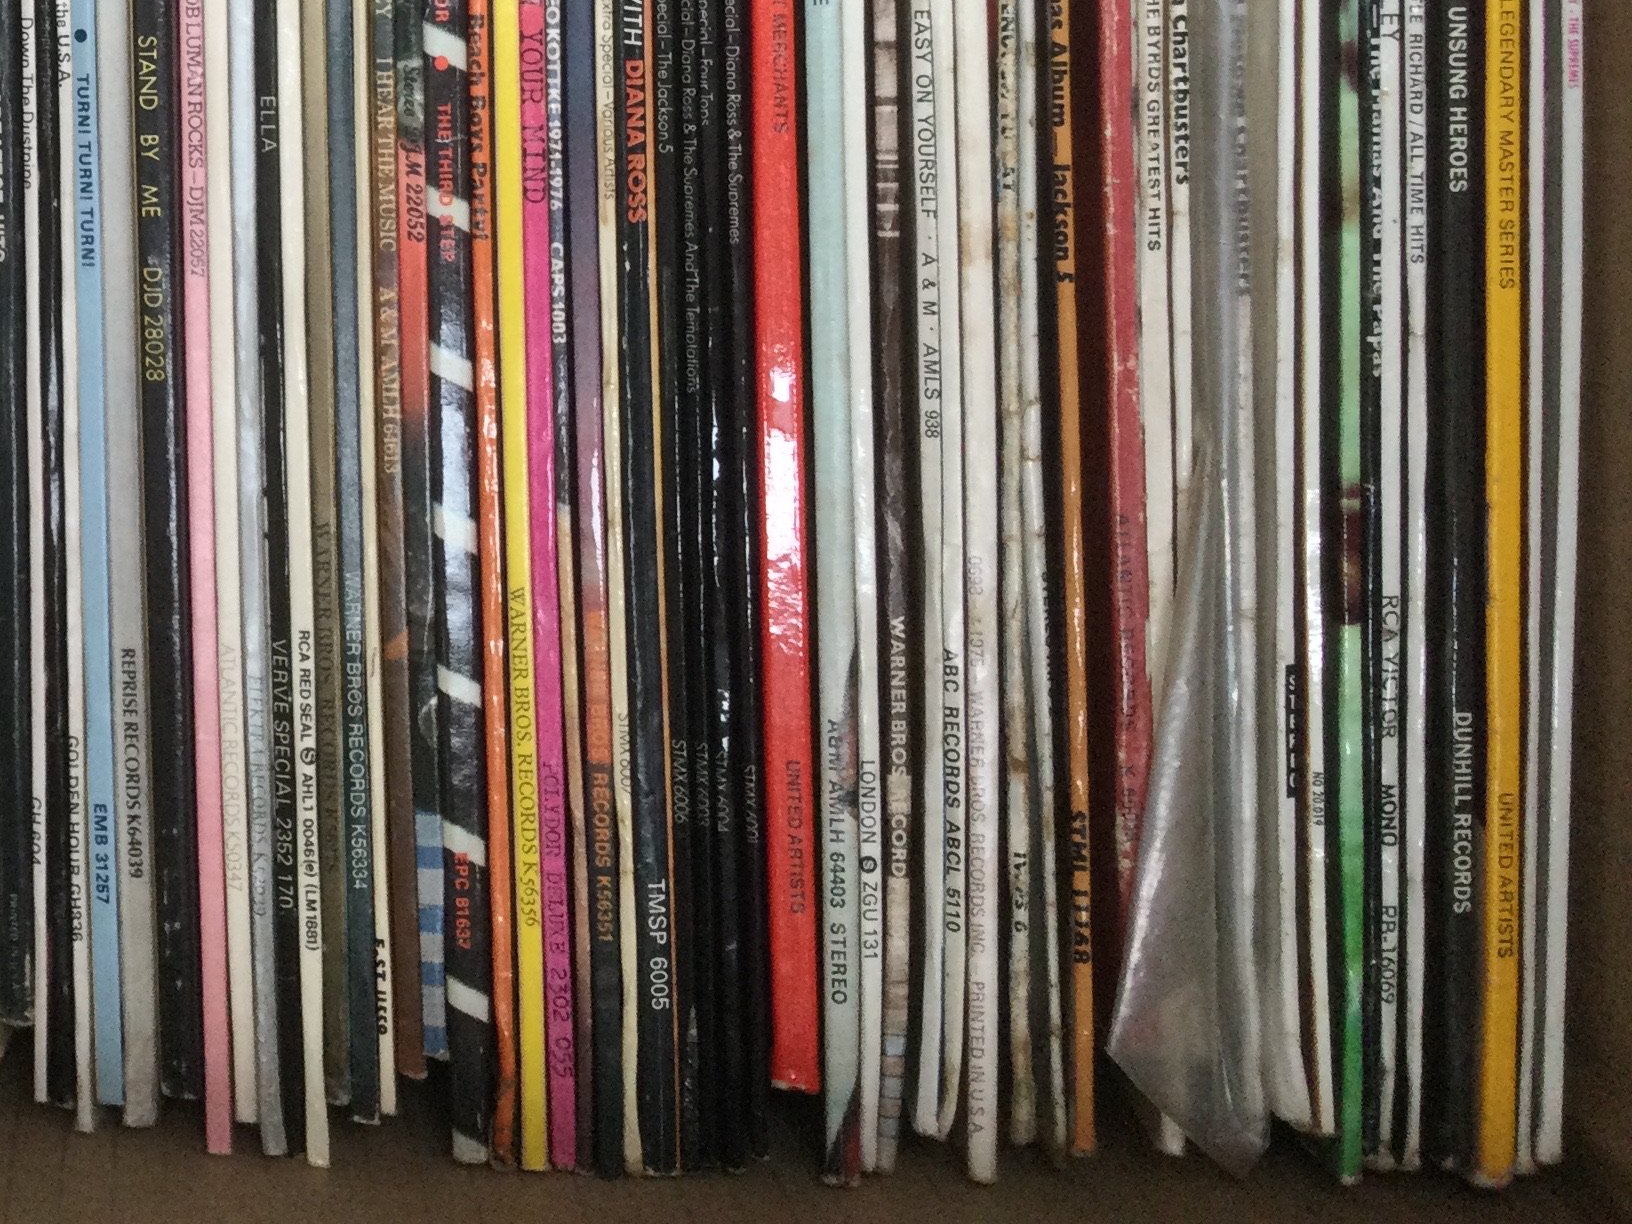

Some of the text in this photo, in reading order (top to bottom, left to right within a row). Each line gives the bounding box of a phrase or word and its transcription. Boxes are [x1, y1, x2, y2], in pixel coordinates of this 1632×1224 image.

[657, 53, 671, 78] The
[914, 9, 931, 63] EASY
[1410, 34, 1423, 114] RICHARD
[1449, 6, 1467, 98] UNSUNG
[626, 59, 645, 148] DIANA
[657, 81, 671, 140] Jackson
[916, 75, 933, 103] ON
[1171, 15, 1190, 185] Chartbusters
[657, 144, 671, 153] 5
[917, 115, 936, 219] YOURSELF
[1410, 132, 1424, 161] ALL
[1450, 107, 1467, 192] HEROES
[1499, 130, 1515, 212] MASTER
[139, 36, 163, 380] STAND BY ME DJD 28028
[627, 155, 646, 223] ROSS
[1411, 172, 1424, 214] TIME
[1411, 225, 1424, 263] HITS
[1499, 219, 1515, 288] SERIES
[924, 343, 940, 438] AMLS 938
[299, 630, 313, 663] RCA
[300, 670, 314, 699] RED
[121, 648, 143, 878] REPRISE RECORDS K64039
[300, 704, 315, 741] SEAL
[510, 588, 538, 926] WARNER BROS. RECORDS K56356
[94, 803, 110, 903] EMB 31257
[1453, 713, 1473, 912] DUNHILL RECORDS
[1498, 793, 1513, 957] UNITED ARTISTS
[648, 879, 669, 1010] TMSP 6005
